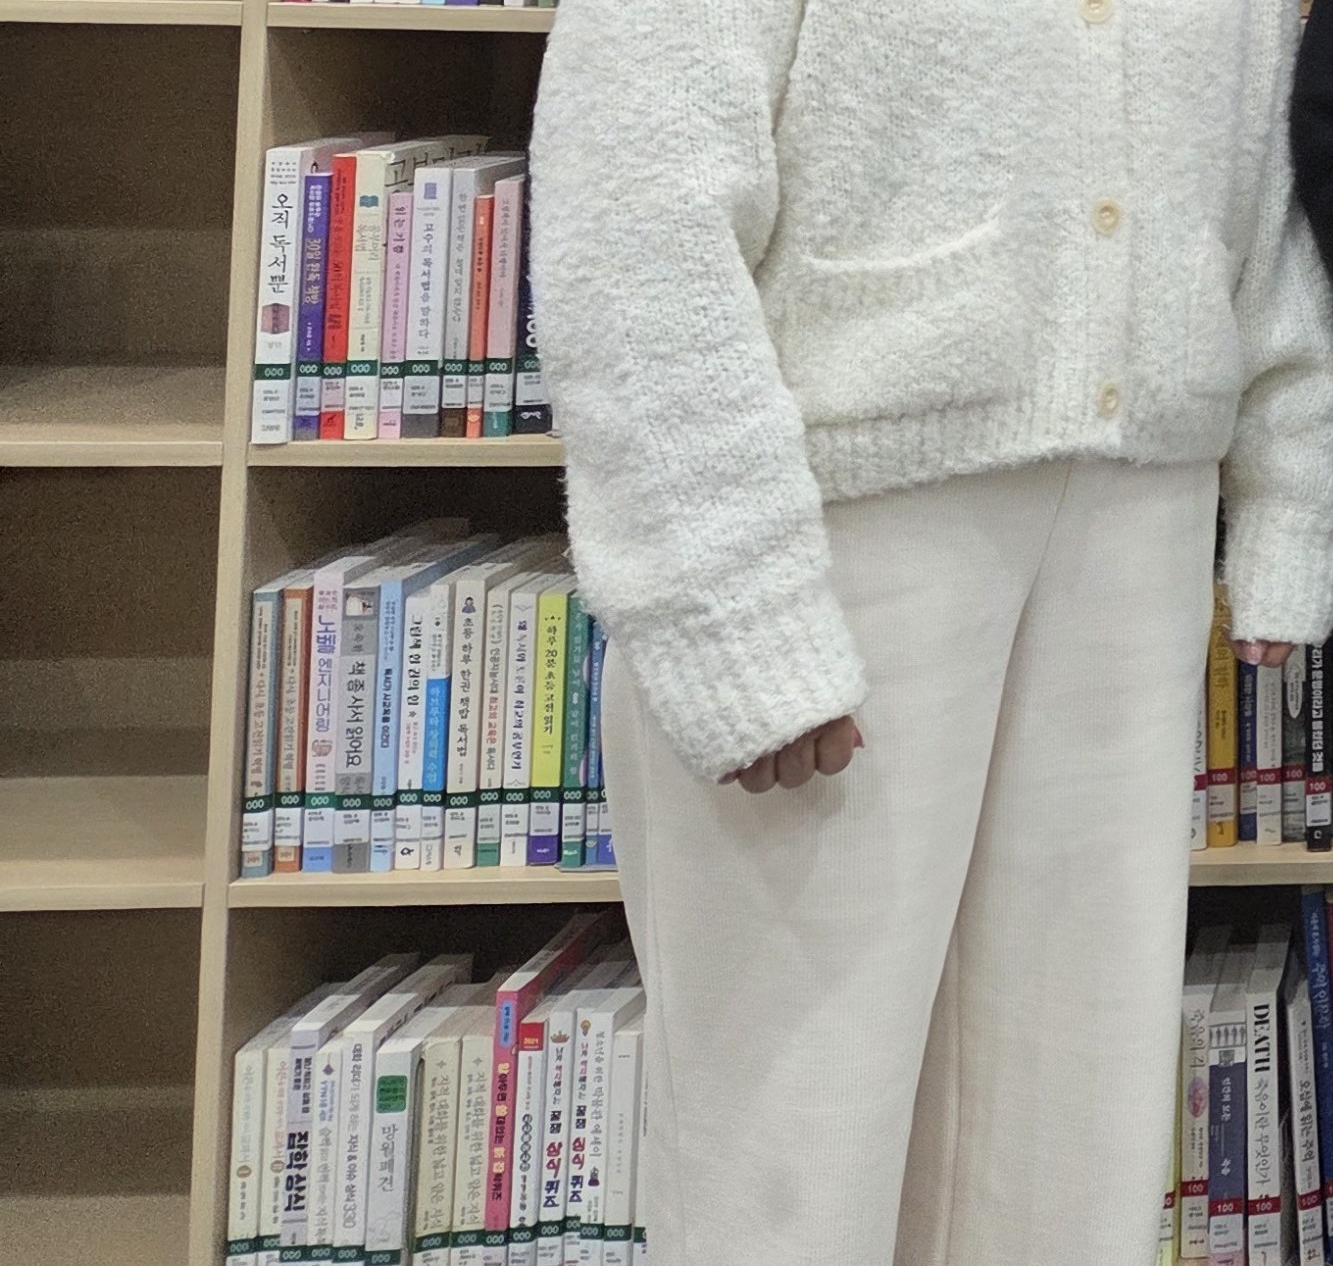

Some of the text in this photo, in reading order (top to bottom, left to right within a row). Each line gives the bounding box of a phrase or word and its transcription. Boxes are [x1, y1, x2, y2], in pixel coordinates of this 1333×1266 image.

[393, 206, 407, 231] 읽는
[267, 193, 293, 294] 오직 독서뿐
[423, 223, 433, 253] 고수의
[489, 363, 506, 371] 000
[1312, 645, 1324, 668] 리가
[315, 614, 337, 733] 노벨 엔지니어링
[1312, 670, 1324, 719] 운명이라고
[345, 660, 366, 768] 책 좀 사서 읽어요
[450, 796, 468, 806] 000
[1309, 782, 1325, 790] 100
[1253, 1003, 1271, 1073] DEATH
[284, 1131, 309, 1213] 잡학 상식
[546, 1141, 562, 1178] 상식
[1254, 1133, 1271, 1186] 무엇인가
[542, 1179, 560, 1208] 퀴즈
[458, 1234, 476, 1245] 000
